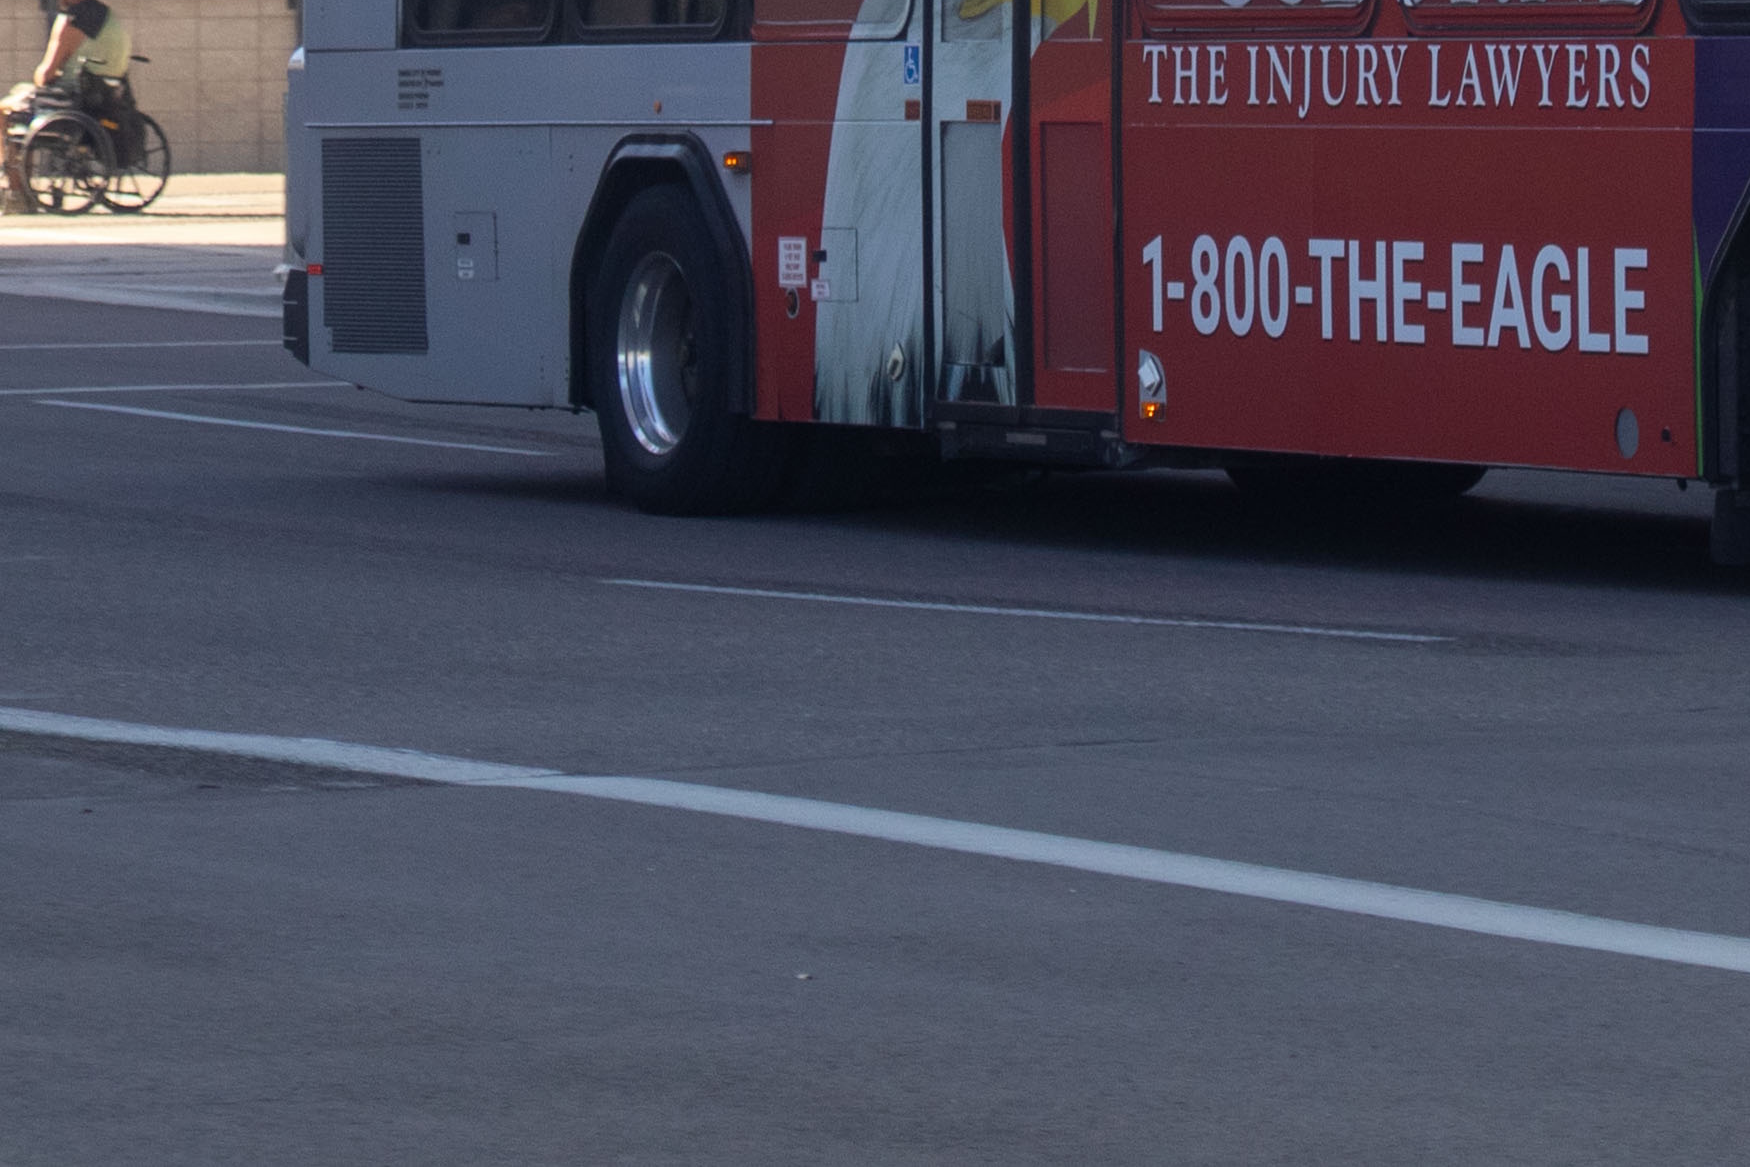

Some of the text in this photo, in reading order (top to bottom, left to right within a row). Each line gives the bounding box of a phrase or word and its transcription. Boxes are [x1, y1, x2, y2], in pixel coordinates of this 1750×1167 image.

[1143, 44, 1651, 118] THE INJURY LAWYERS
[1142, 234, 1649, 355] 1-800-THE-EAGLE
